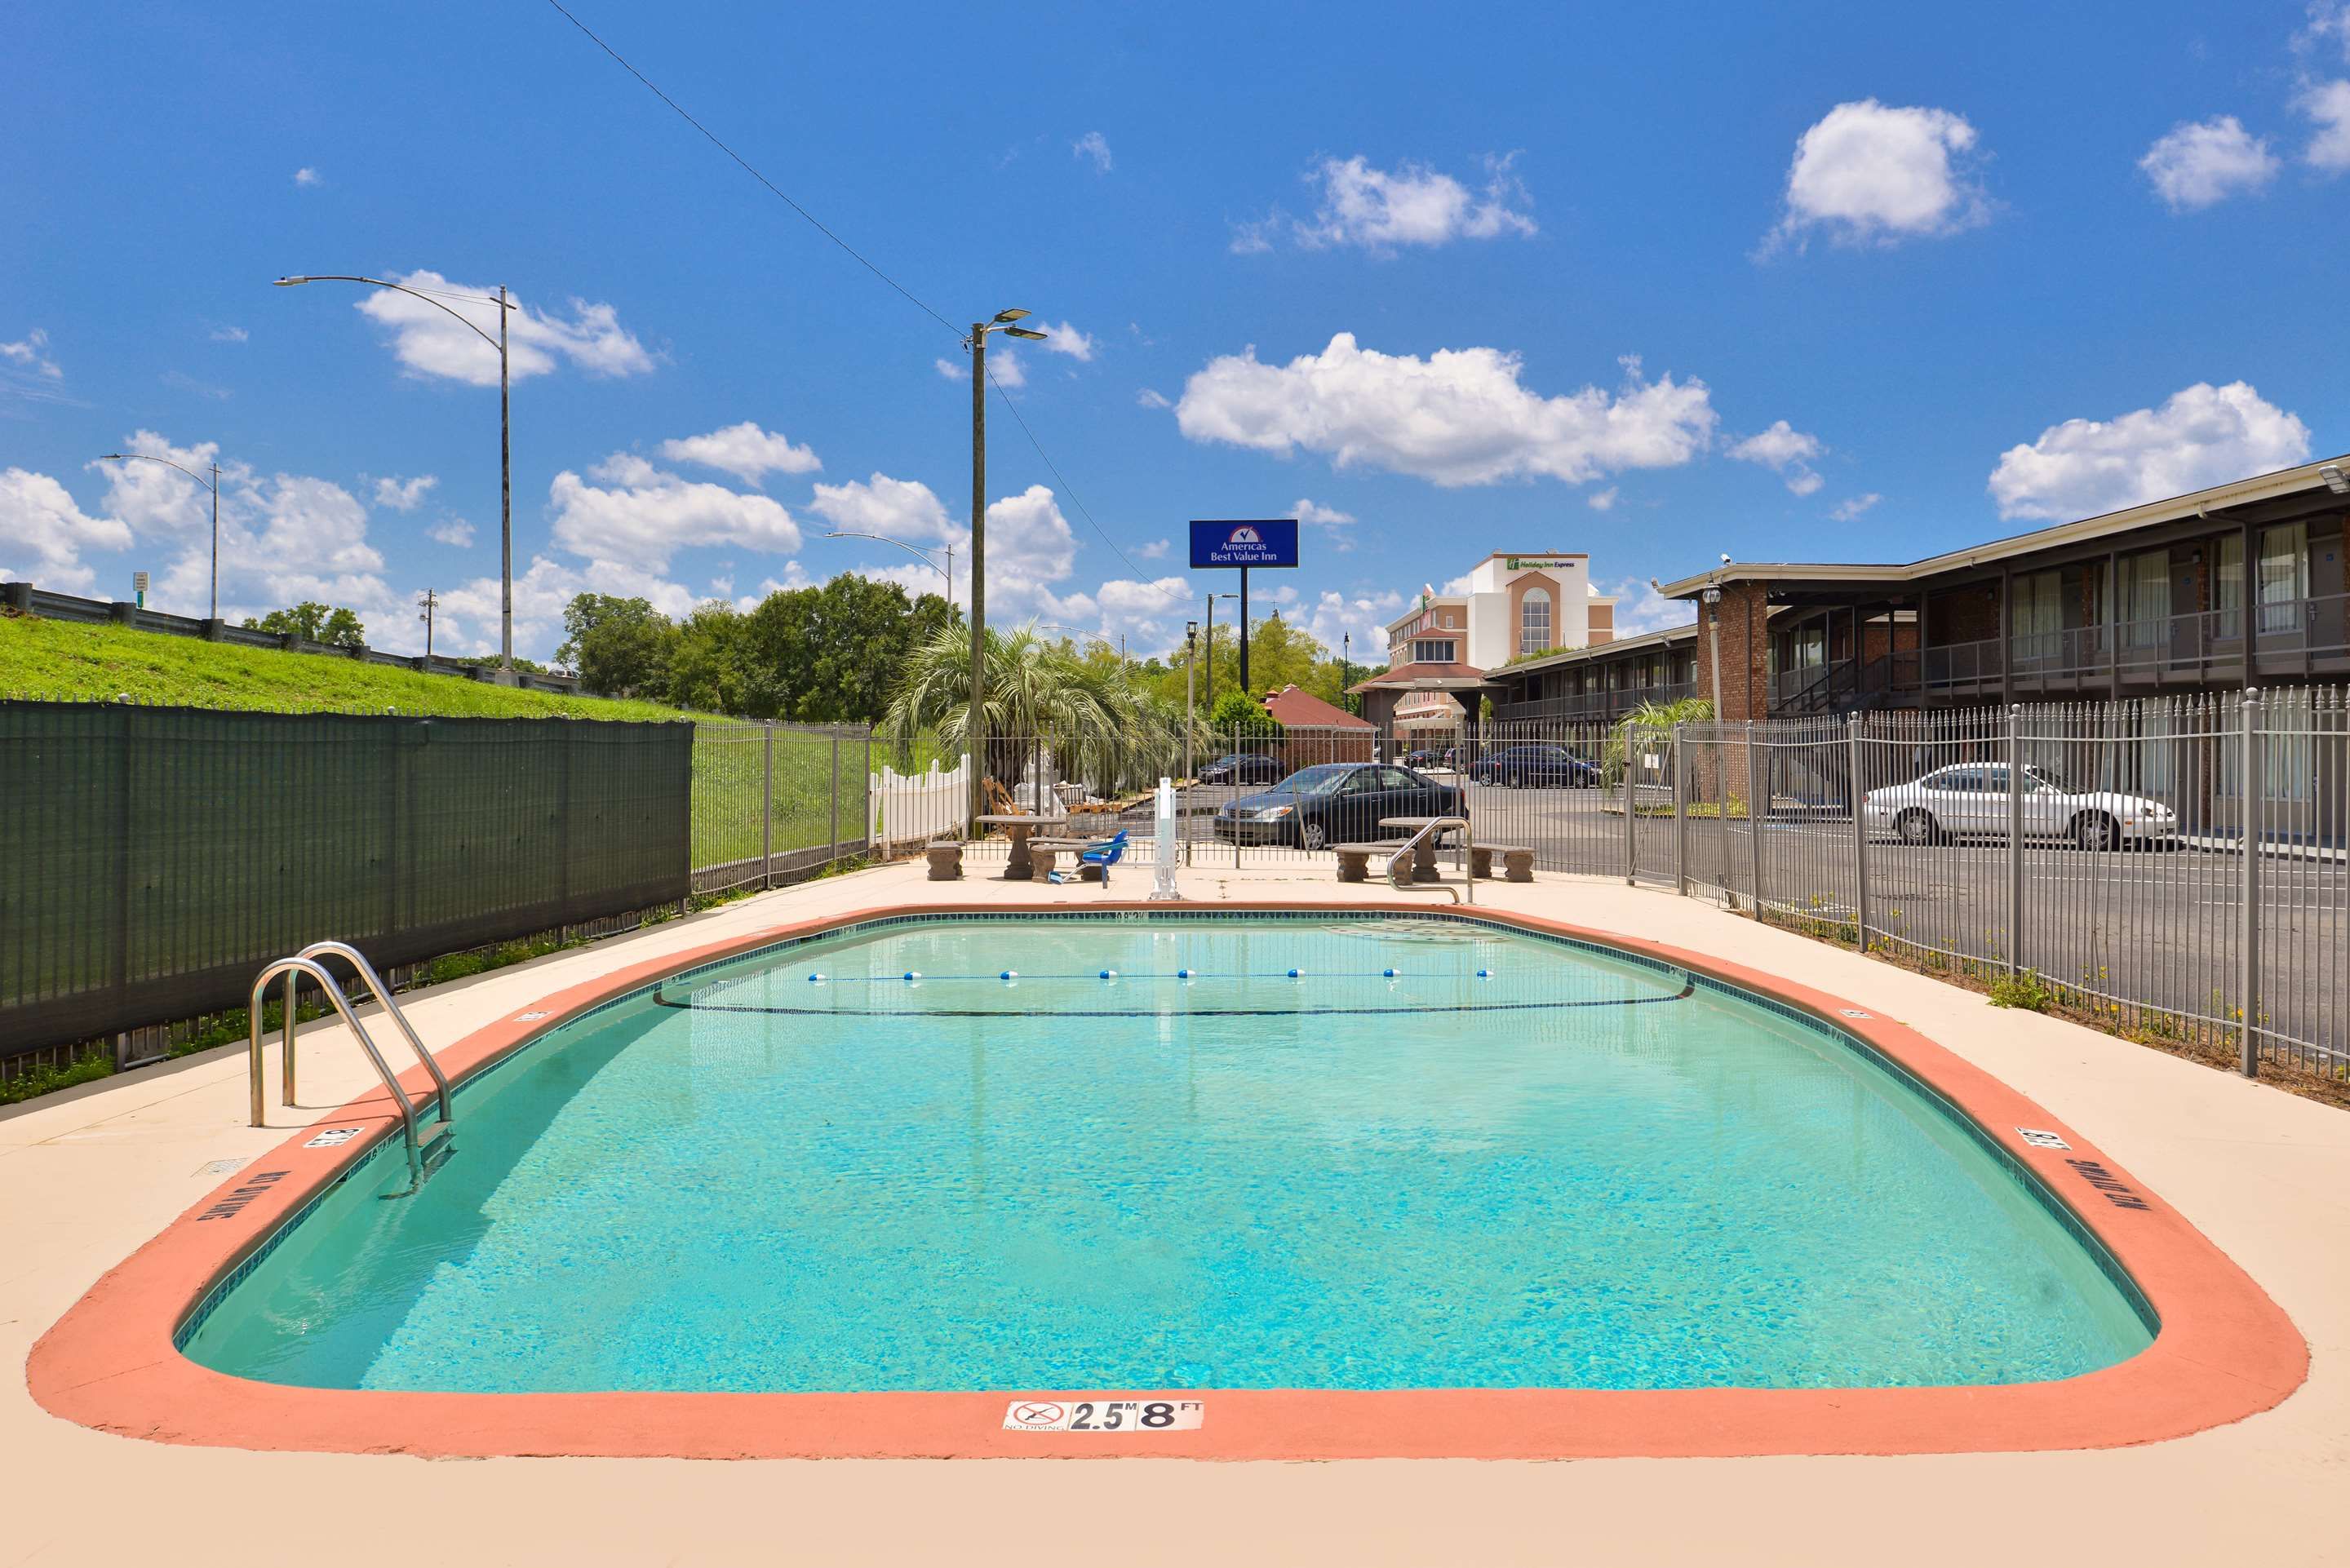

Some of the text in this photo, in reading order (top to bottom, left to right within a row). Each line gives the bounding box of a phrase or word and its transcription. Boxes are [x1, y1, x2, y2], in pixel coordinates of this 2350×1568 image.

[1222, 543, 1266, 551] Americas
[1211, 551, 1277, 561] Best Value Inn
[1141, 1402, 1175, 1428] 8
[1181, 1402, 1204, 1411] FT
